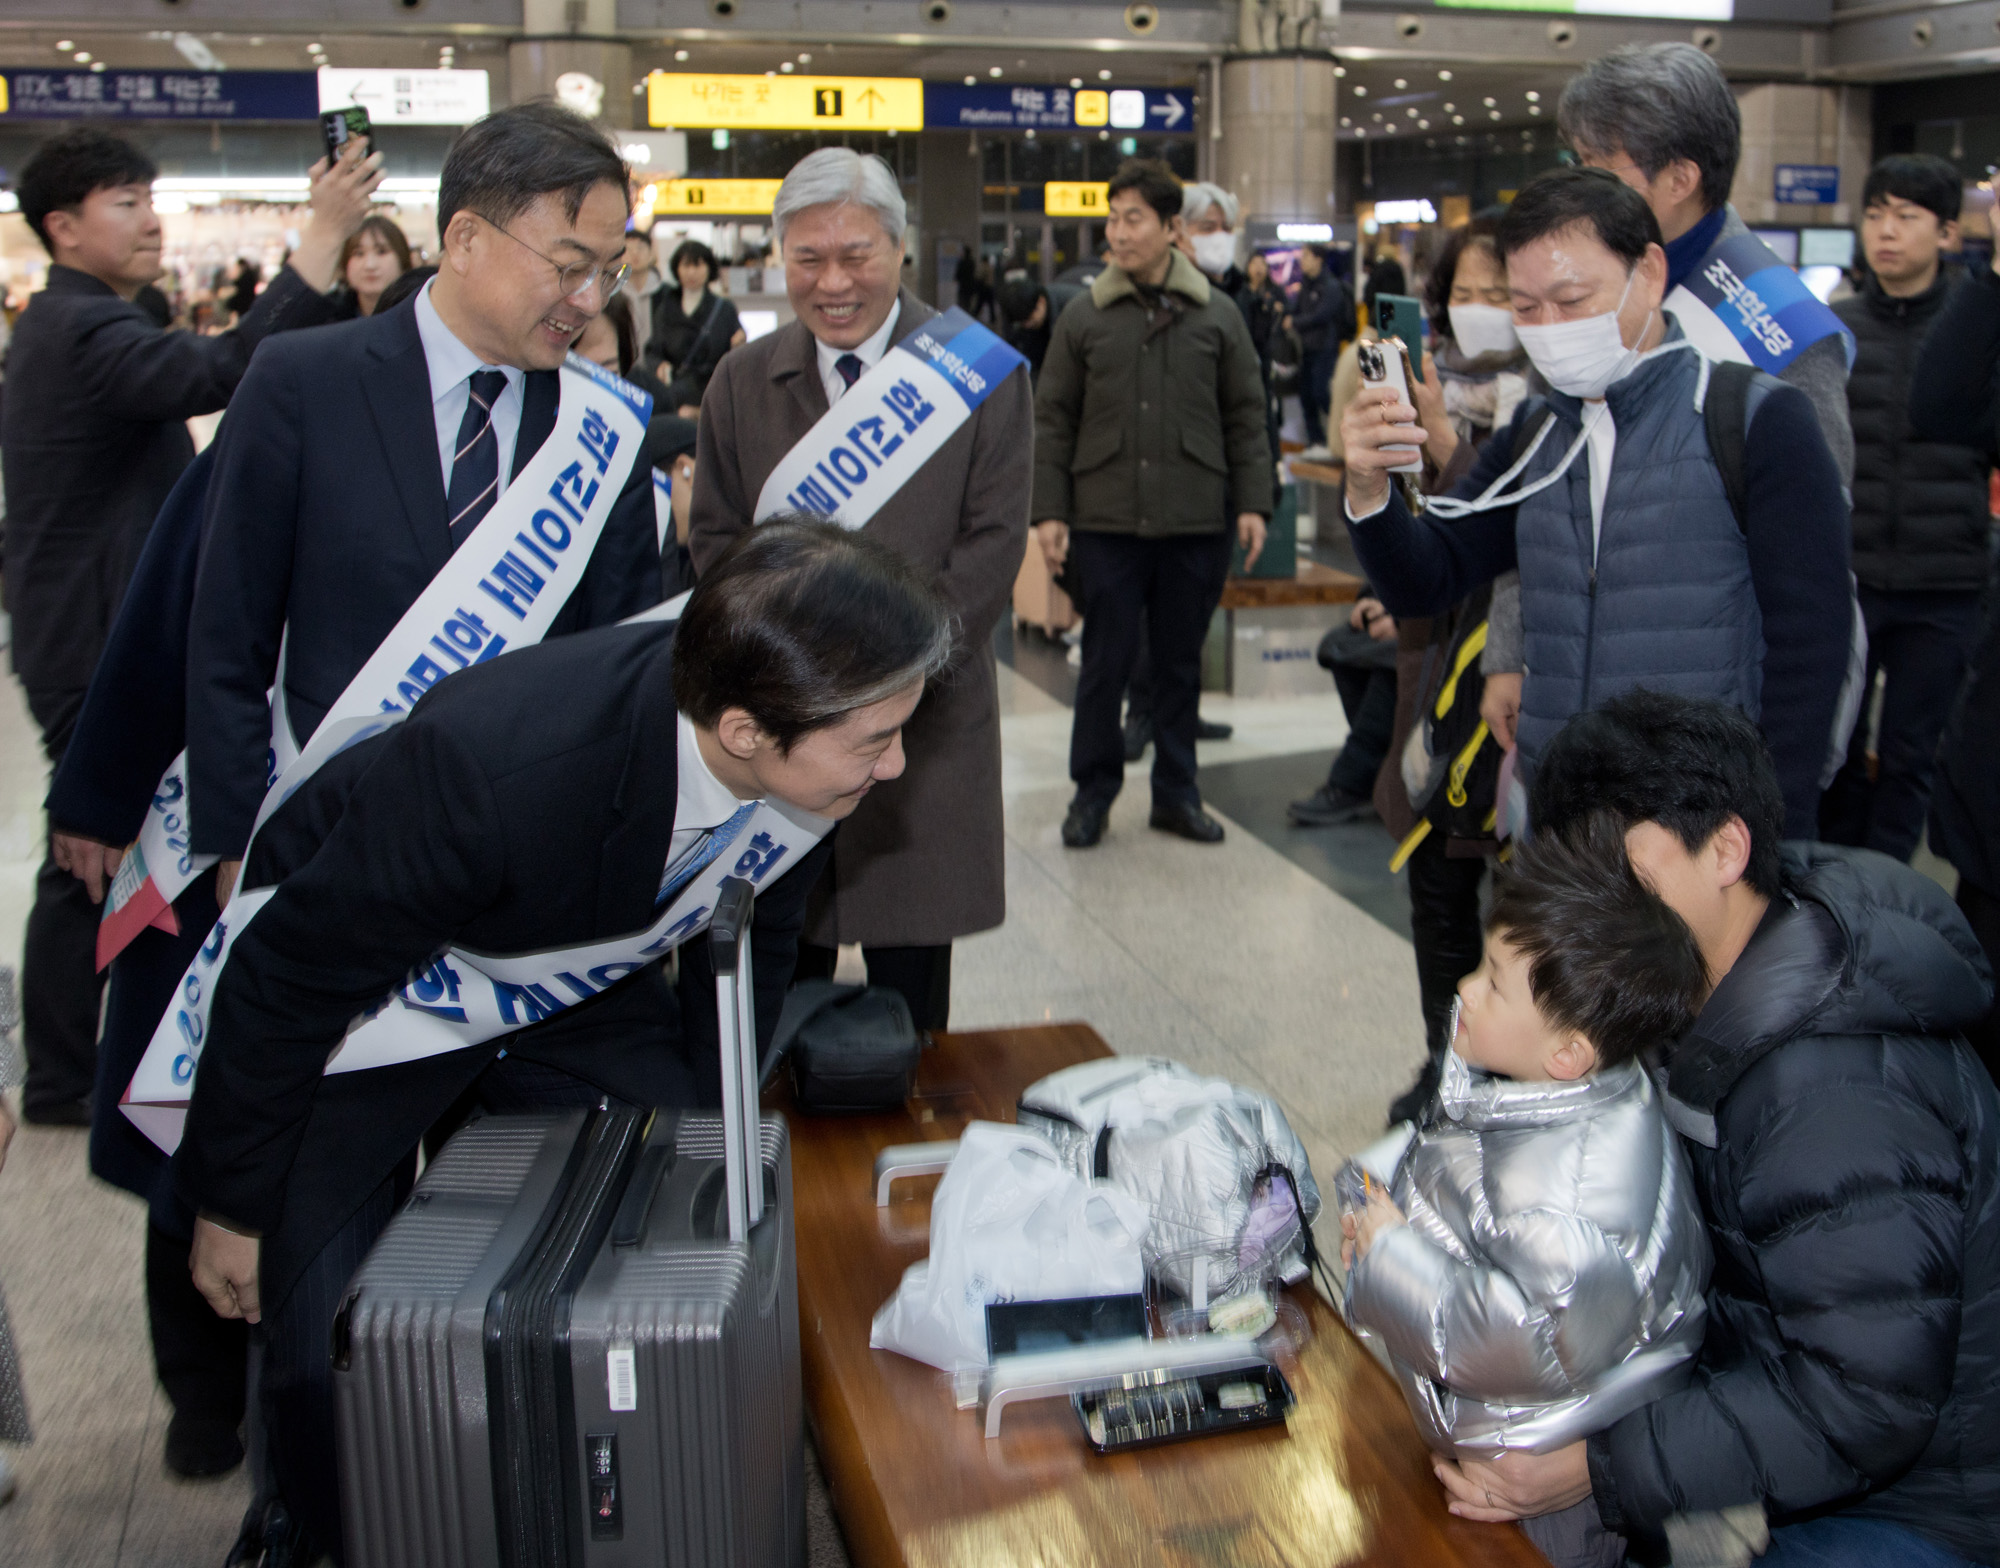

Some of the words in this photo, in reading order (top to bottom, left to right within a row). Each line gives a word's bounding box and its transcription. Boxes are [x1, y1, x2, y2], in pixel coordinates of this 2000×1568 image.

[691, 82, 743, 103] 나가는
[754, 83, 770, 104] 곳
[821, 90, 836, 116] 1
[1703, 258, 1794, 356] 조국혁신당
[913, 333, 987, 395] 조국혁신당
[477, 404, 620, 622] 혁신으로
